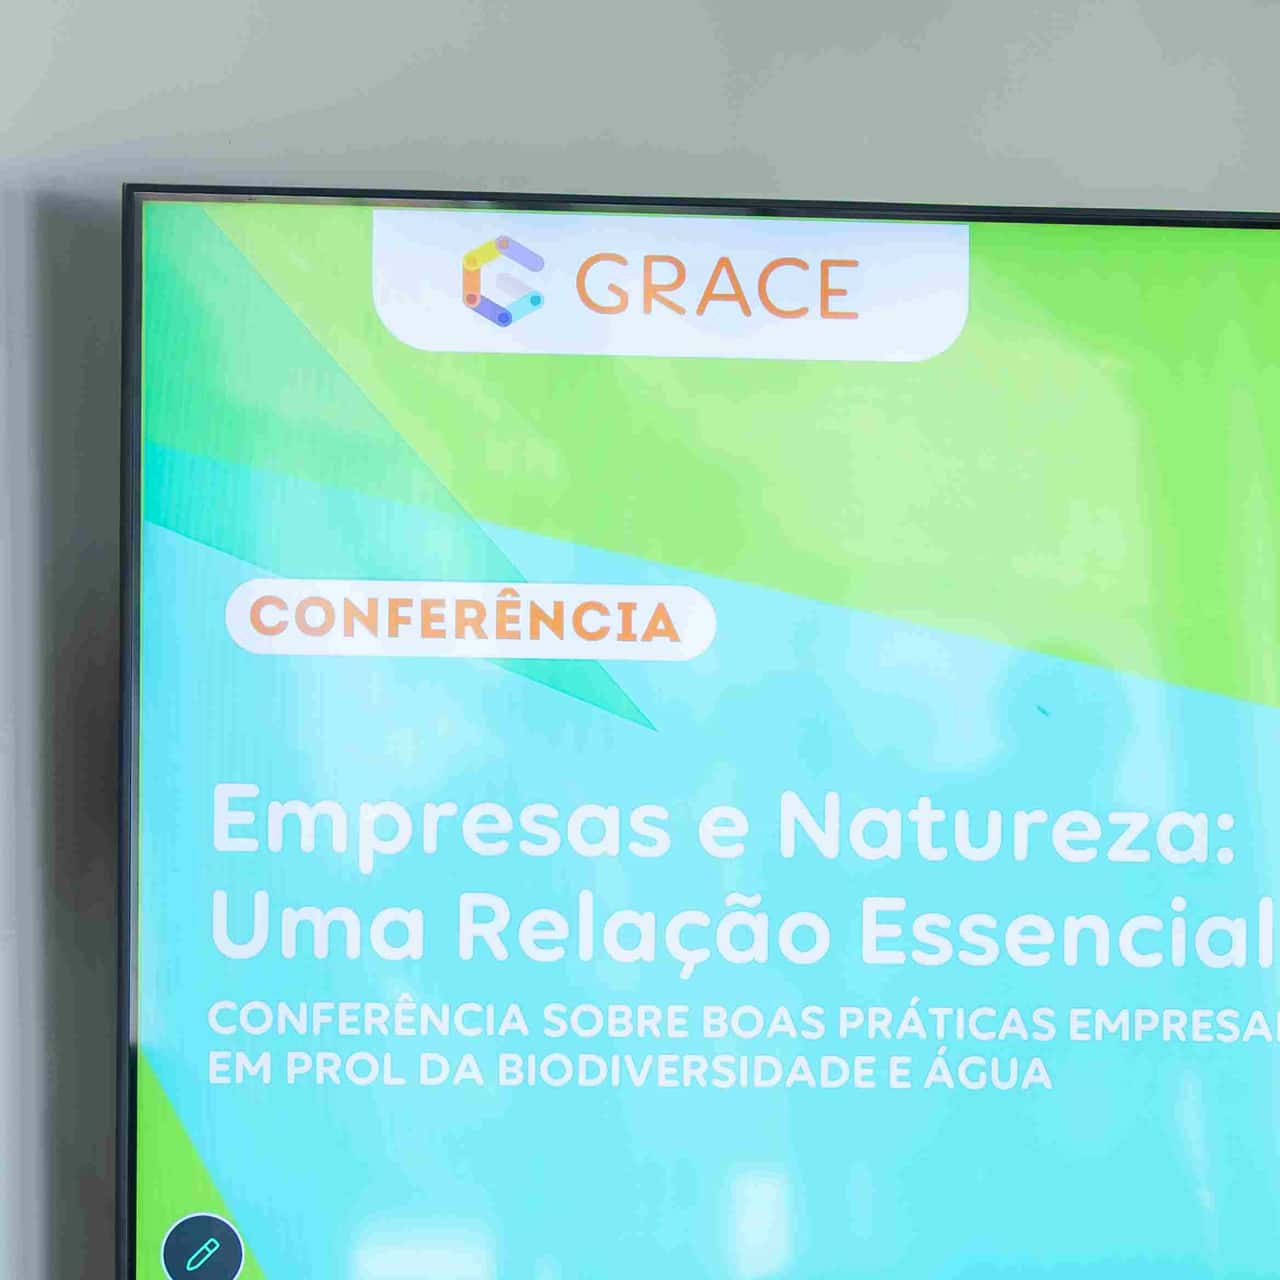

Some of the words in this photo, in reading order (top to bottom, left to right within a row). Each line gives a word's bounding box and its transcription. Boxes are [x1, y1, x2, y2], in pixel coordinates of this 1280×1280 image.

[576, 253, 860, 321] GRACE
[249, 587, 681, 643] CONFERÊNCIA
[212, 783, 671, 874] Empresas
[698, 804, 750, 859] e
[780, 790, 1236, 865] Natureza:
[211, 890, 424, 960] Uma
[458, 889, 831, 980] Relação
[861, 896, 1274, 968] Essencial
[207, 993, 529, 1037] CONFERÊNCIA
[543, 1004, 689, 1039] SOBRE
[703, 1005, 825, 1040] BOAS
[839, 996, 1056, 1041] PRÁTICAS
[208, 1051, 271, 1085] EM
[286, 1052, 406, 1086] PROL
[420, 1053, 485, 1086] DA
[499, 1053, 876, 1089] BIODIVERSIDADE
[889, 1055, 912, 1088] E
[924, 1047, 1052, 1090] ÁGUA
